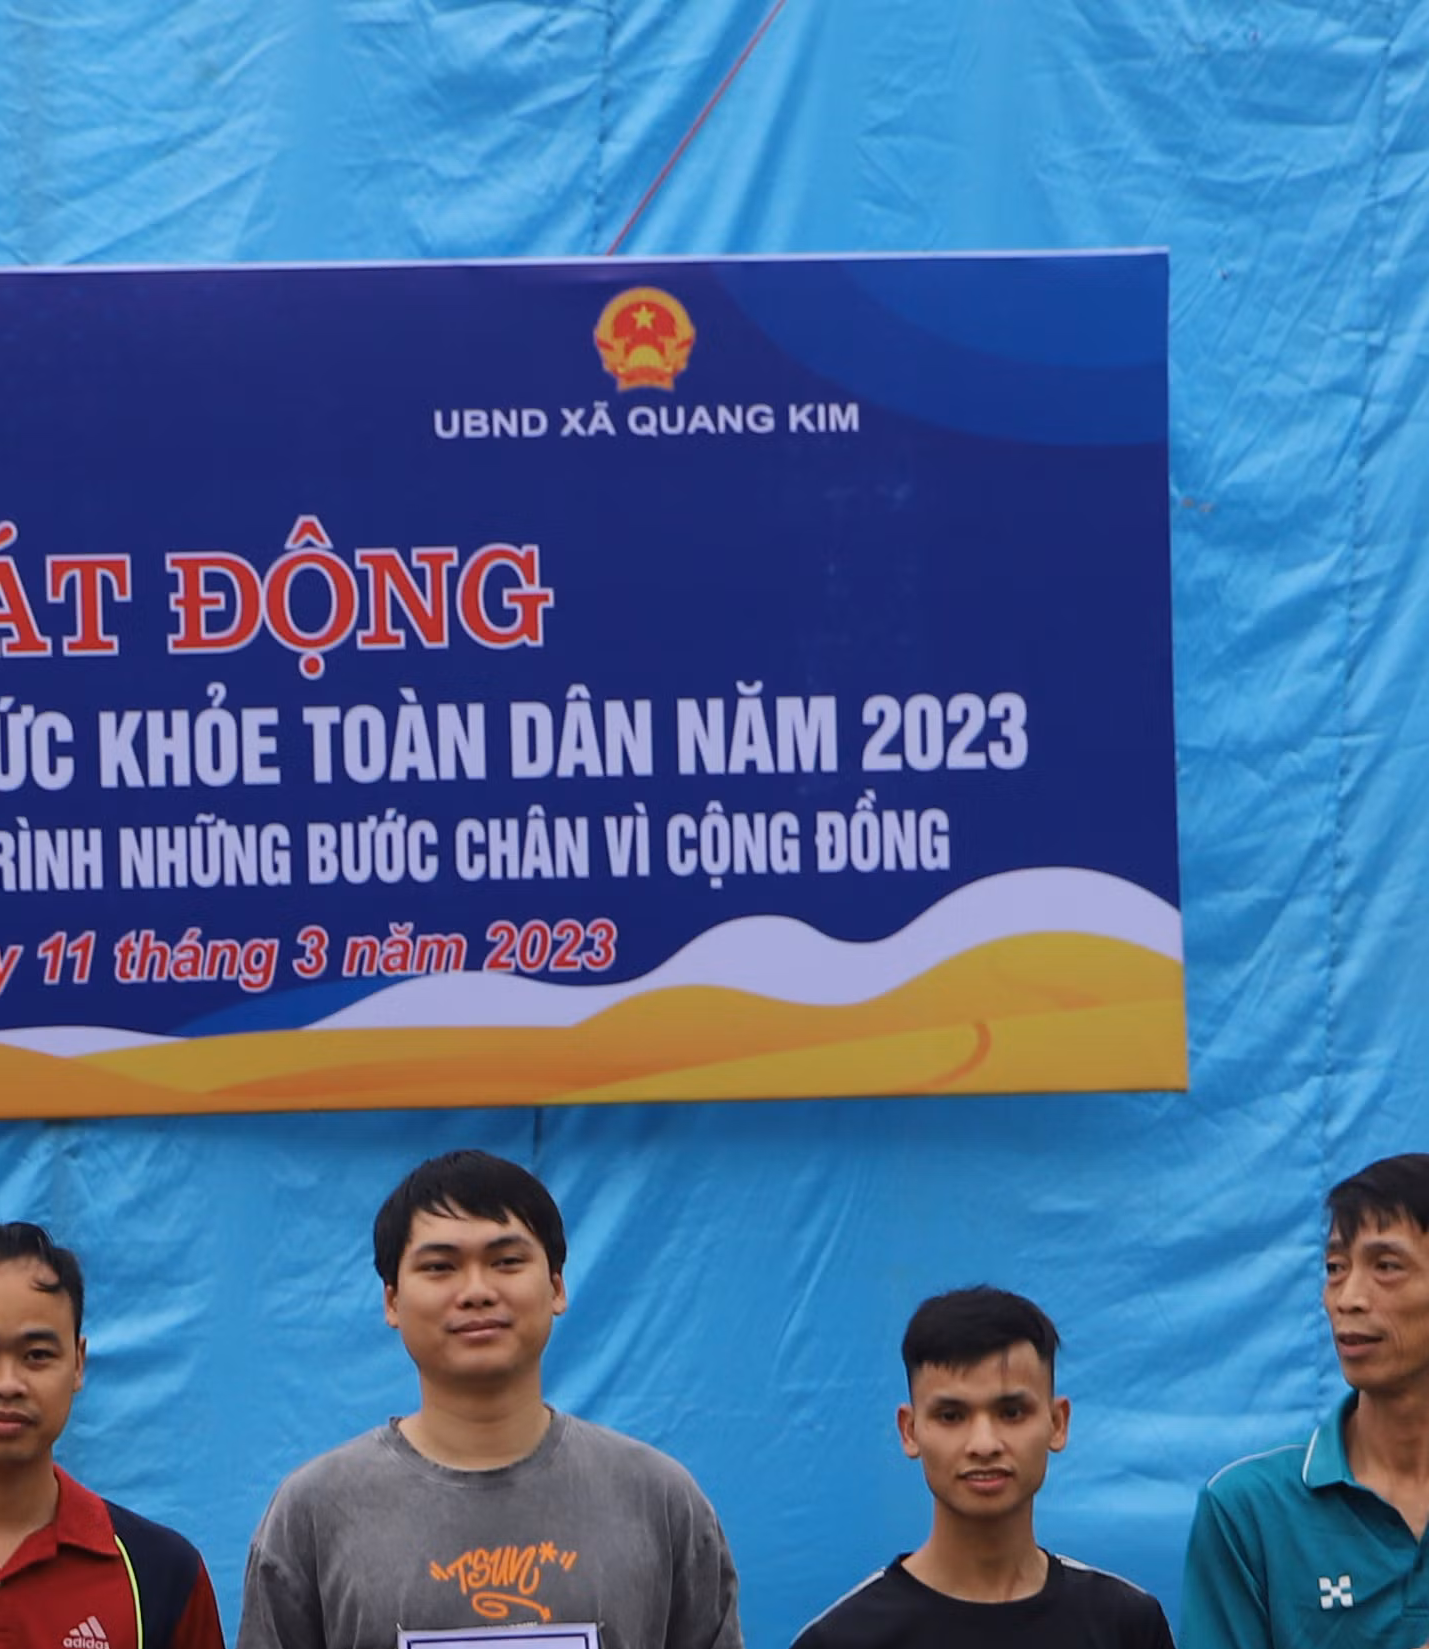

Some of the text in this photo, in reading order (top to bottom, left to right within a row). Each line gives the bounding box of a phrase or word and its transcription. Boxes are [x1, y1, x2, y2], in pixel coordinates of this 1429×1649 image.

[434, 402, 859, 438] UBND XÃ QUANG KIM
[165, 514, 553, 680] ĐỘNG
[98, 683, 281, 790] KHỎE
[303, 686, 486, 784] TOÀN
[510, 683, 653, 779] DÂN
[676, 681, 838, 773] NĂM
[861, 690, 1028, 772] 2023
[119, 811, 292, 891] NHỮNG
[307, 807, 439, 885] BƯỚC
[455, 805, 590, 881] CHÂN
[605, 802, 651, 877] VÌ
[666, 801, 800, 889] CỘNG
[816, 789, 950, 872] ĐỒNG
[37, 932, 93, 983] 11
[113, 928, 277, 991] tháng
[293, 926, 330, 978] 3
[342, 923, 466, 978] năm
[484, 918, 618, 973] 2023
